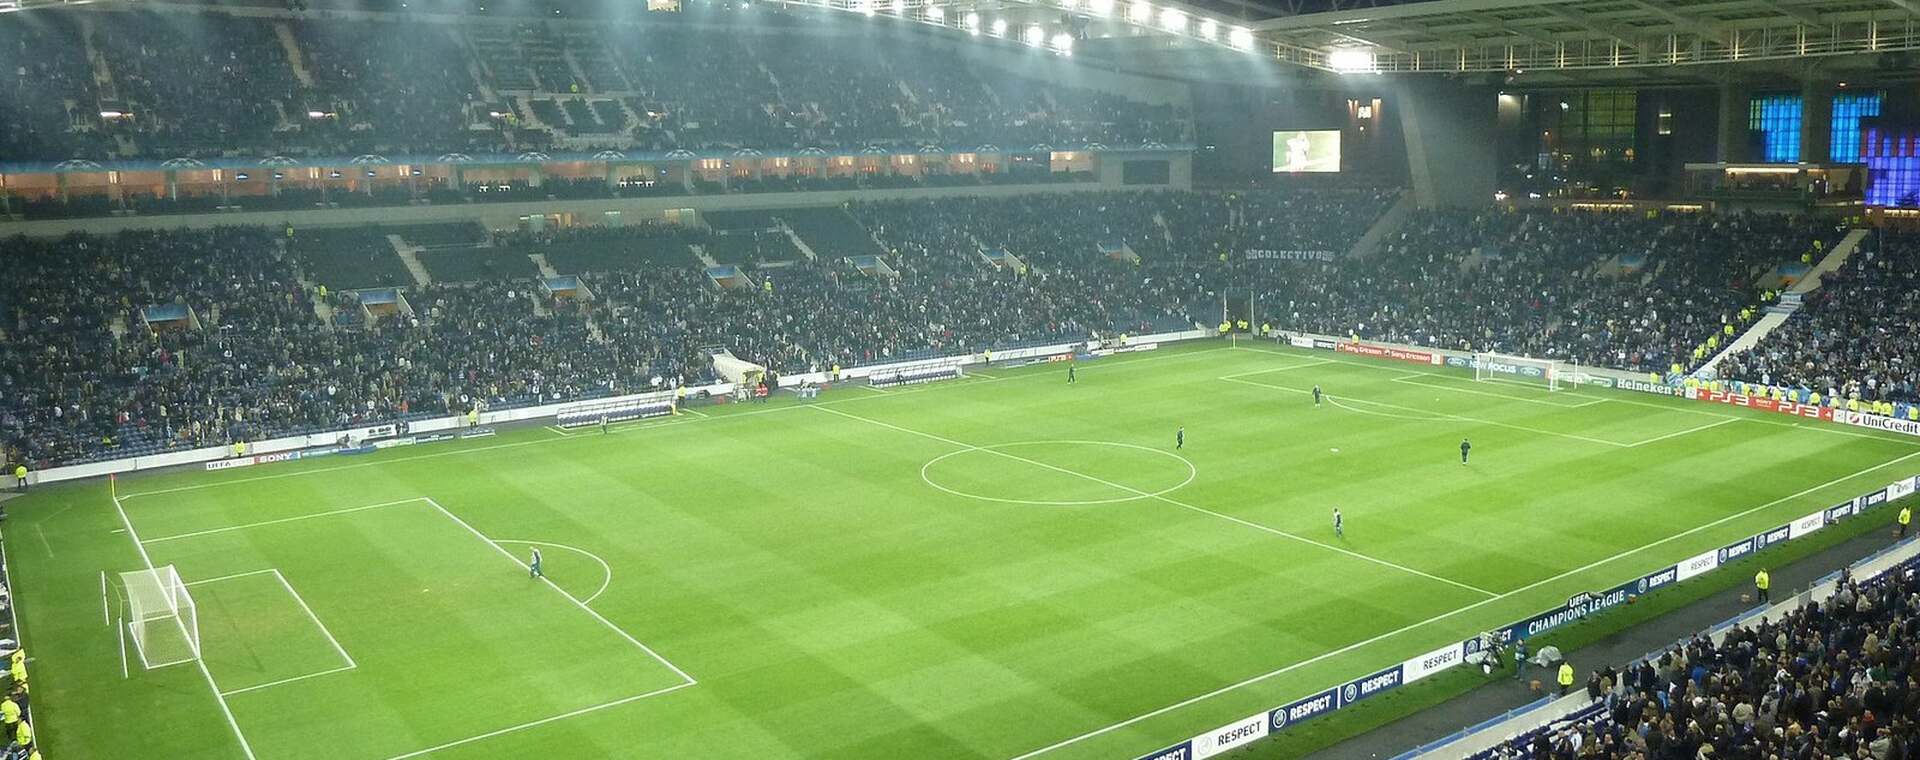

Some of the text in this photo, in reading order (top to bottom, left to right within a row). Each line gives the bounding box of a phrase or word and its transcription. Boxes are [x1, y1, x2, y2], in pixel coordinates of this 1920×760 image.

[1258, 249, 1321, 260] COLECTIVO
[1345, 344, 1382, 356] Sony Ericsson
[1391, 350, 1430, 361] Sony Ericsson
[1617, 378, 1672, 395] Heineken
[1710, 390, 1749, 406] PS3
[1778, 400, 1819, 418] PS3
[1862, 414, 1919, 434] UniCredit
[259, 452, 292, 463] SONY
[1728, 541, 1752, 558] RESPECT
[1691, 555, 1714, 571] RESPECT
[1649, 569, 1675, 588] RESPECT
[1569, 593, 1592, 608] UEFA
[1528, 590, 1625, 635] CHAMPIONS LEAGUE
[1423, 650, 1458, 671] RESPECT
[1361, 670, 1399, 694] RESPECT
[1289, 695, 1331, 721] RESPECT
[1217, 721, 1262, 746] RESPECT
